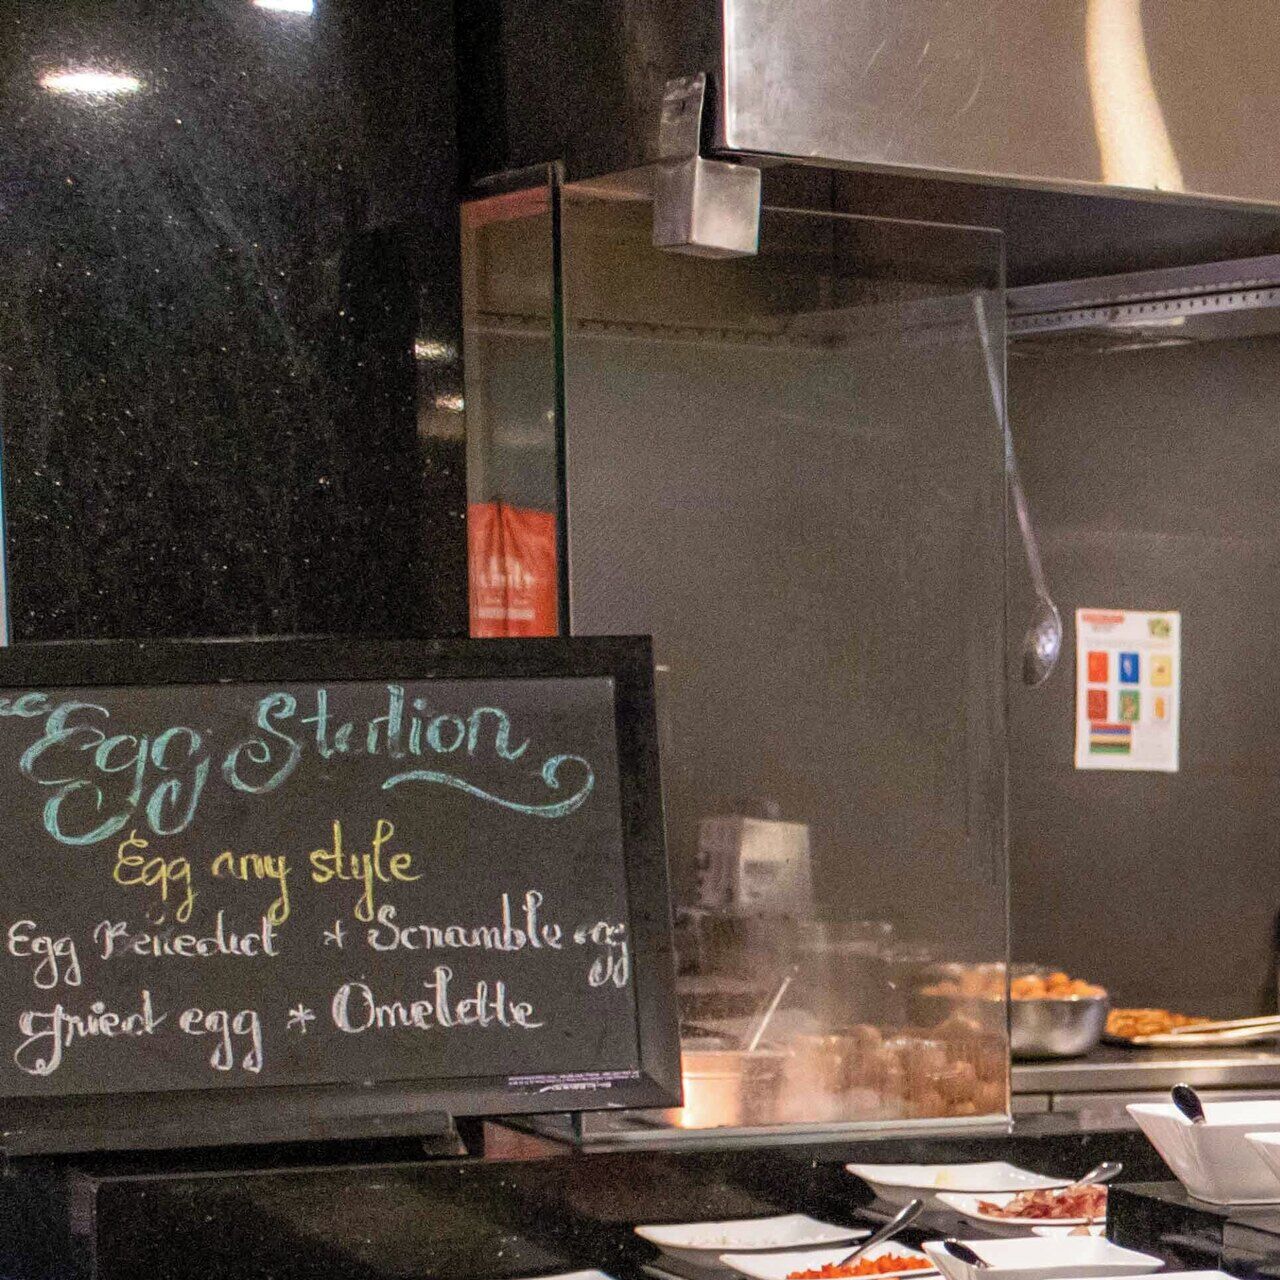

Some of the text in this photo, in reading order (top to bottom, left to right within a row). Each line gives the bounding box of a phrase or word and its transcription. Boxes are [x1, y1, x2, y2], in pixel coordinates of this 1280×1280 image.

[0, 690, 209, 846] Egg
[113, 819, 422, 926] Egg any style
[8, 919, 82, 989] Egg
[179, 1007, 264, 1074] egg
[331, 966, 544, 1034] Omelette
